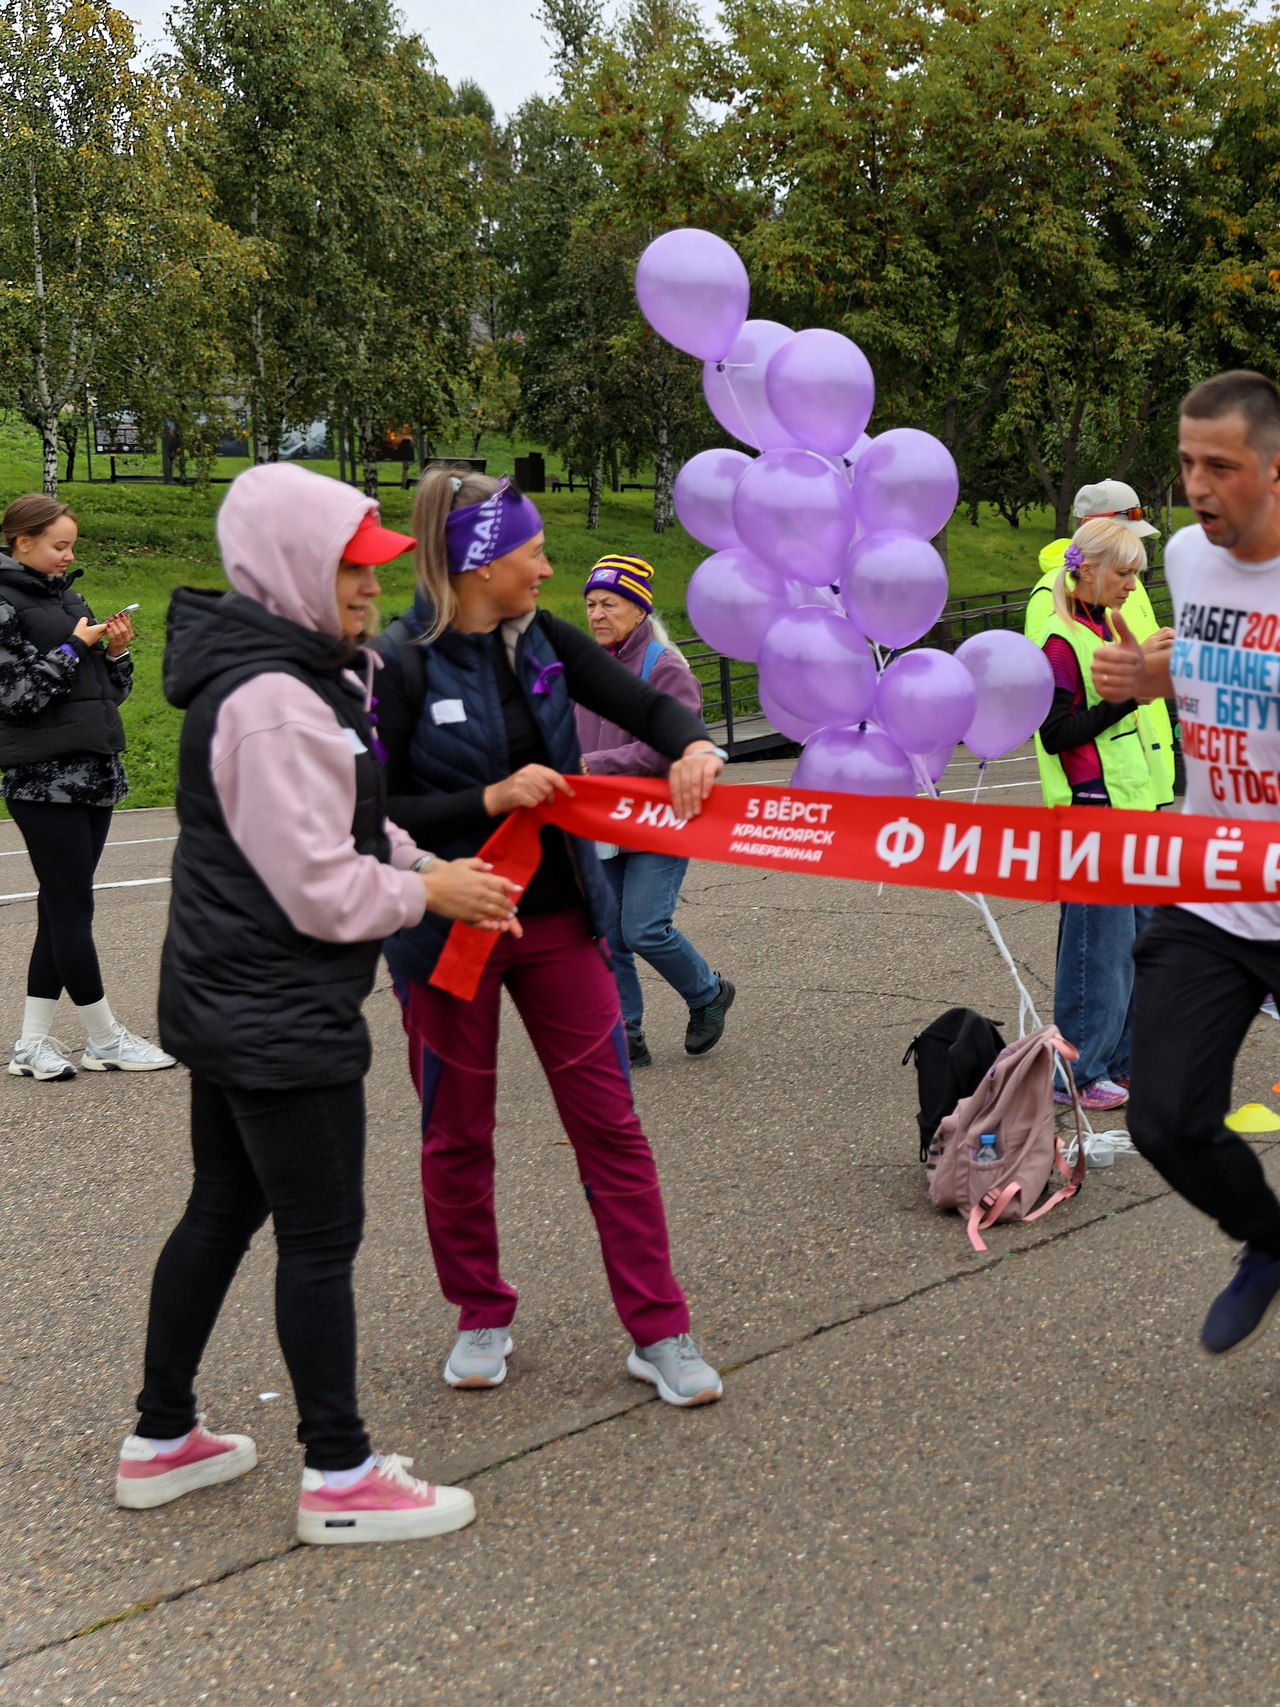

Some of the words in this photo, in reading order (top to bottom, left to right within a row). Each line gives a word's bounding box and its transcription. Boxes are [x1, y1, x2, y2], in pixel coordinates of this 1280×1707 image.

[1209, 764, 1225, 802] С
[610, 797, 635, 820] 5
[746, 799, 761, 818] 5
[763, 796, 833, 824] ВЁРСТ
[732, 823, 836, 845] КРАСНОЯРСК
[729, 841, 823, 862] НАБЕРЕЖНАЯ
